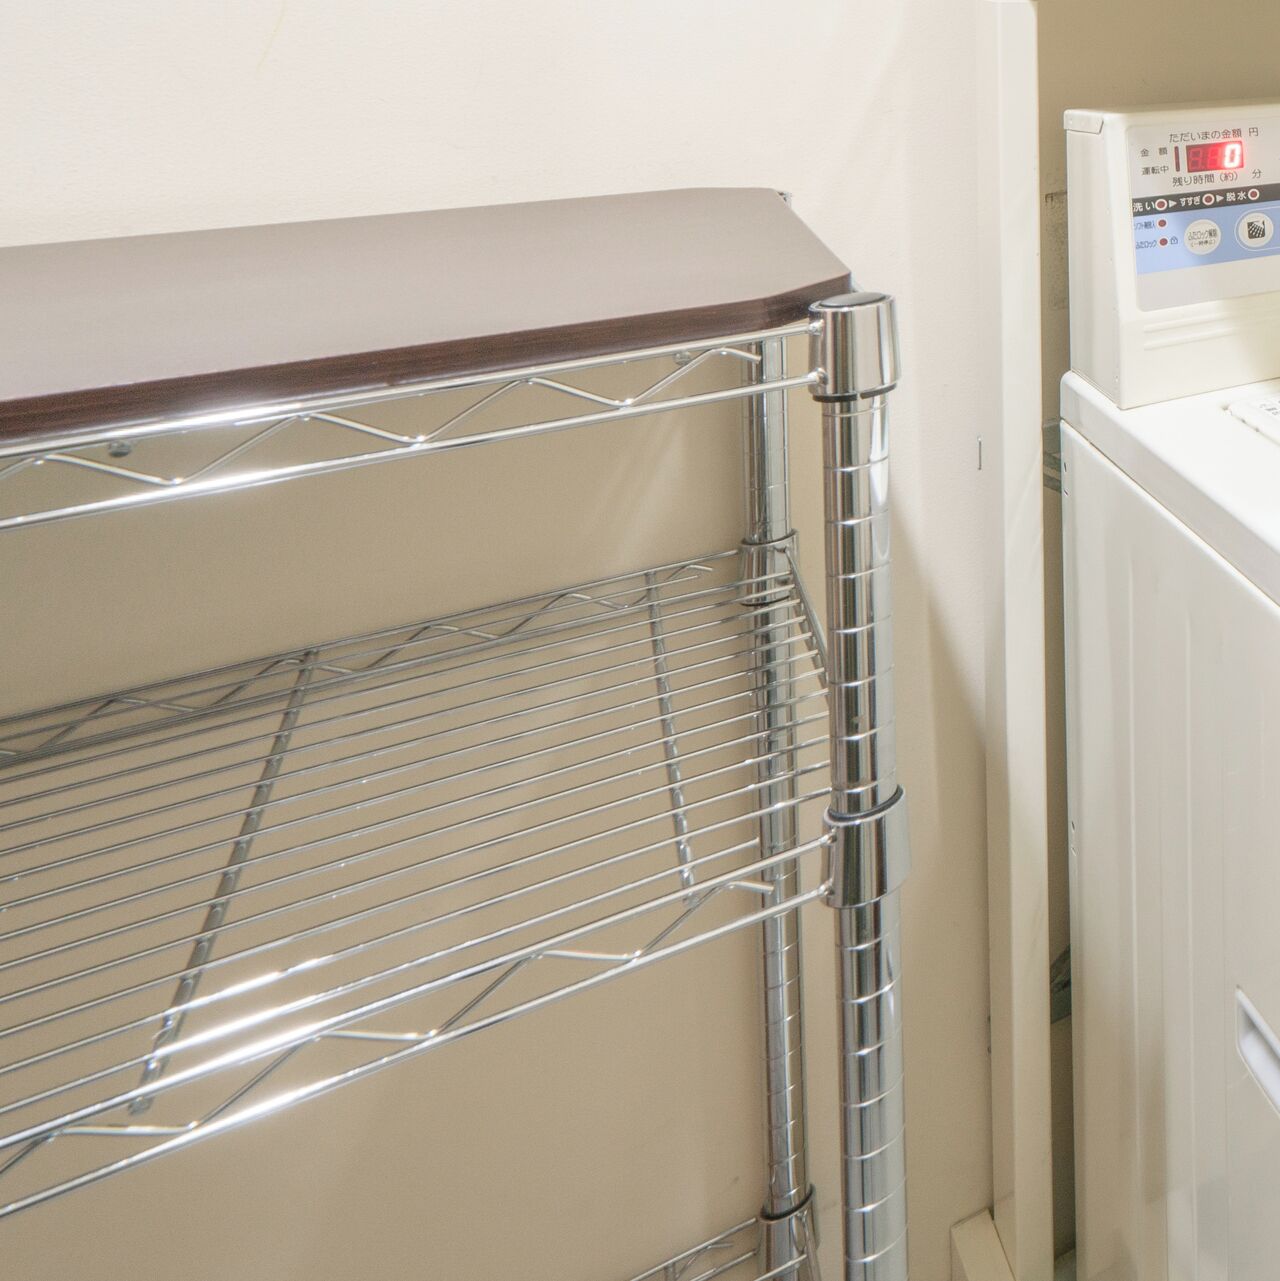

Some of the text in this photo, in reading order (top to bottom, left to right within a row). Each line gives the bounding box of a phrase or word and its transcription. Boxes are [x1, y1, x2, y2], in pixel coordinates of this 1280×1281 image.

[1169, 127, 1259, 143] ただいまの金額 円
[1140, 147, 1168, 158] 金額
[1223, 143, 1242, 169] 0
[1141, 164, 1169, 175] 運転中
[1252, 169, 1262, 179] 分
[1133, 190, 1248, 212] 洗い すすぎ 脱水
